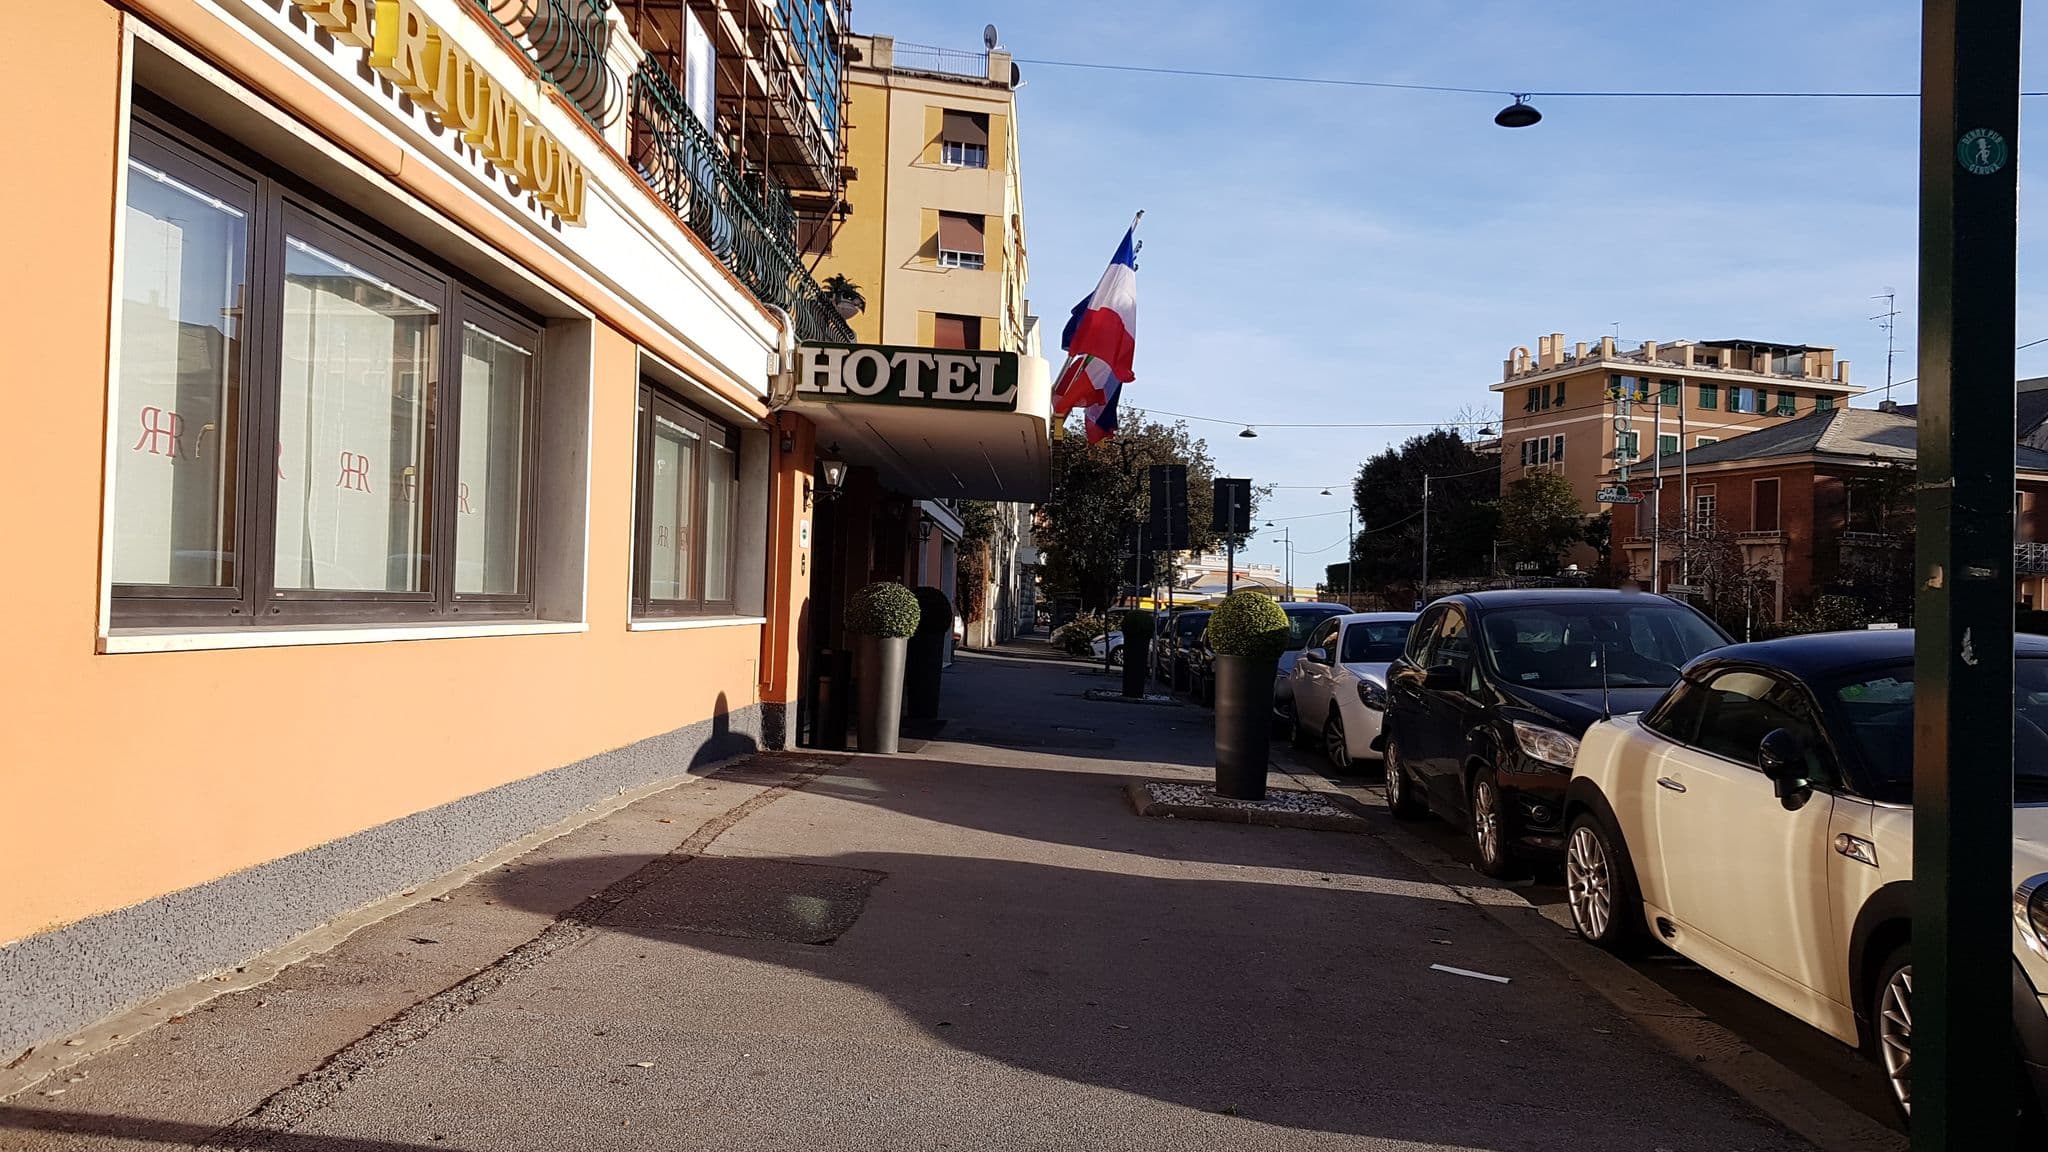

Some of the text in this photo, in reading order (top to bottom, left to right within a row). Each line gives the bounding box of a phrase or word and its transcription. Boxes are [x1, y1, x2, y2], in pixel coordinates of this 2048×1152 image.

[370, 0, 588, 228] RIUNIONI
[796, 347, 1018, 404] HOTEL
[1414, 600, 1423, 610] P
